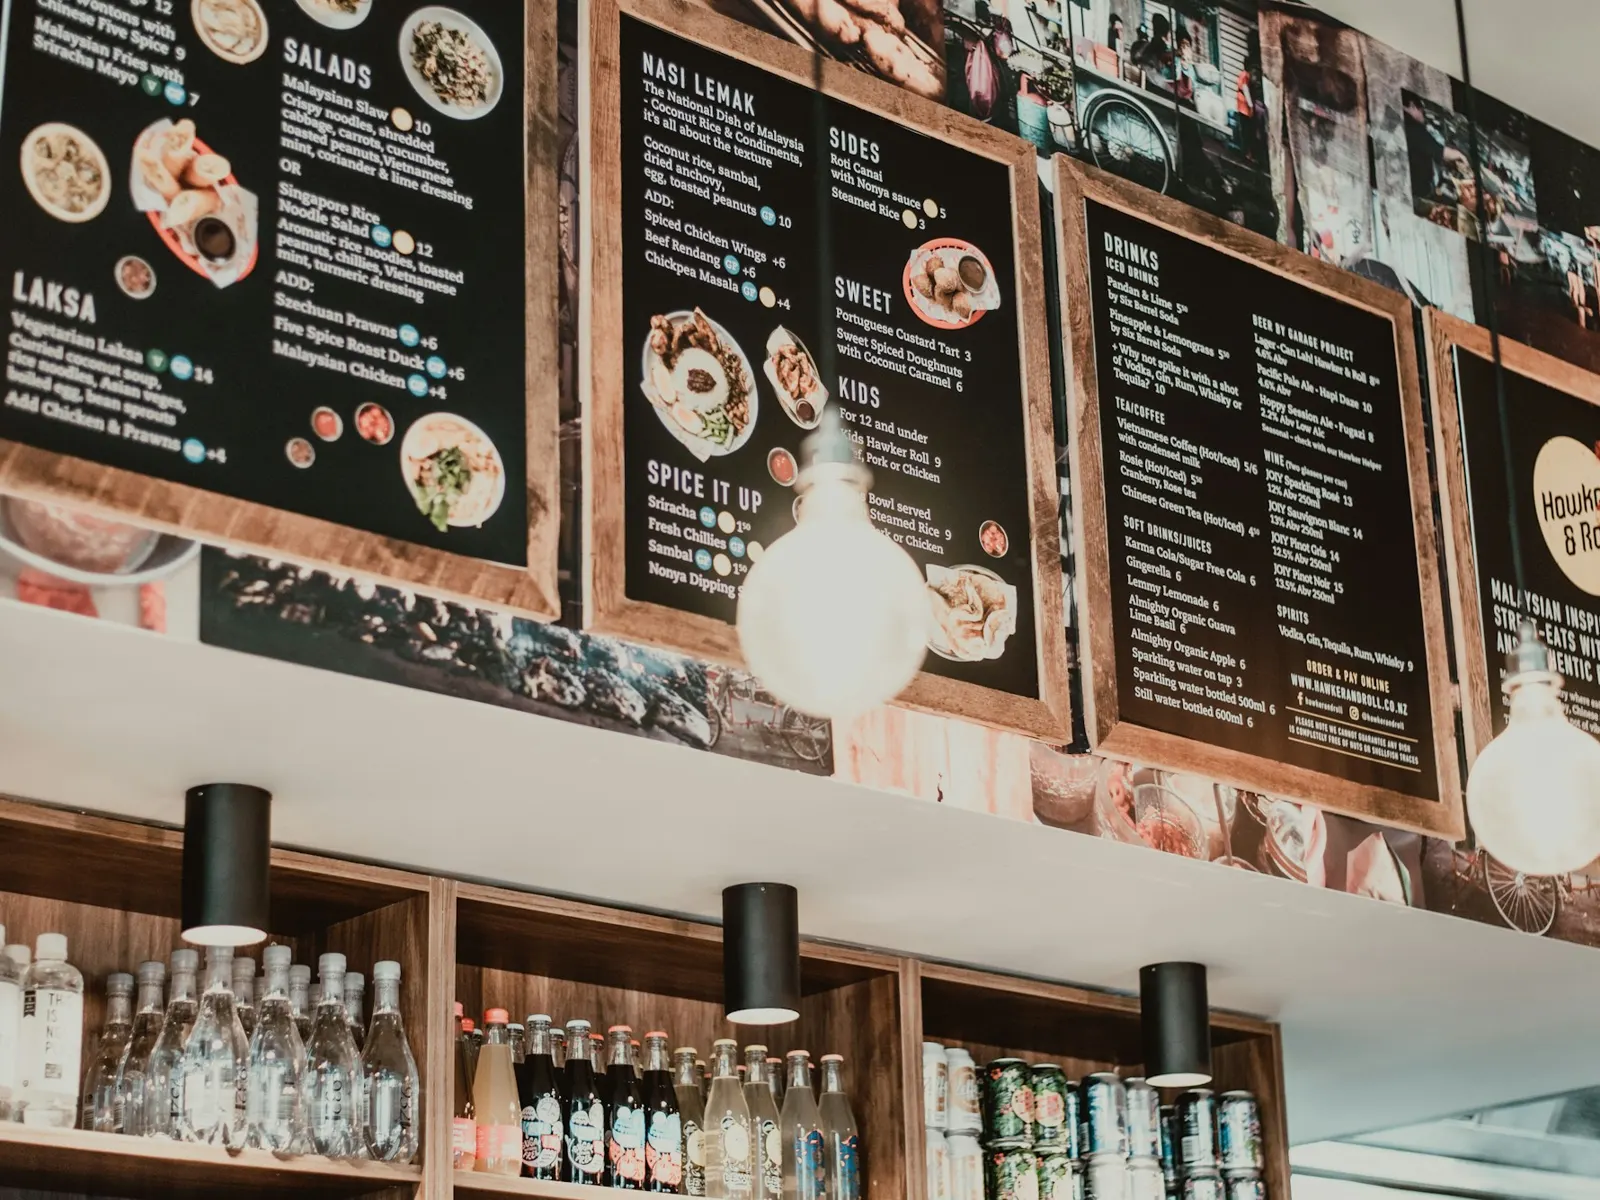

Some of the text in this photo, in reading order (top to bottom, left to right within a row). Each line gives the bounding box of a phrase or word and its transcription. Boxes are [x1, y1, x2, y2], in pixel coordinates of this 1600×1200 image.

[34, 16, 184, 85] Malaysian Fries with
[284, 38, 371, 90] SALADS
[283, 74, 431, 135] Malaysian Slaw 10
[642, 51, 755, 117] NASI LEMAK
[281, 92, 435, 153] Crispy noodles, shredded
[643, 79, 804, 152] The National Dish of Malaysia
[651, 99, 802, 167] Coconut Rice & Condiments,
[643, 109, 772, 168] it's all about the texture
[829, 126, 880, 164] SIDES
[280, 158, 302, 176] OR
[643, 135, 761, 191] Coconut rice, sambal,
[644, 151, 725, 192] dried anchovy,
[830, 153, 883, 182] Roti Canai
[279, 182, 380, 225] Singapore Rice
[644, 166, 792, 228] egg, toasted peanuts GF 10
[644, 189, 674, 209] ADD:
[831, 169, 946, 219] with Nonya sauce 5
[831, 186, 926, 230] Steamed Rice 3
[278, 198, 433, 258] Noodle Salad 12
[645, 209, 786, 269] Spiced Chicken Wings +6
[645, 229, 756, 278] Beef Rendang GF +6
[1104, 232, 1159, 271] DRINKS
[1106, 256, 1159, 288] ICED DRINKS
[13, 271, 96, 324] LAKSA
[276, 271, 314, 293] ADD:
[645, 250, 790, 310] Chickpea Masala GF +4
[835, 276, 891, 315] SWEET
[1107, 275, 1172, 310] Pandan & Lime
[274, 293, 438, 350] Szechuan Prawns +6
[1108, 289, 1179, 325] by Six Barrel Soda
[274, 316, 465, 381] Five Spice Roast Duck +6
[836, 307, 972, 362] Portuguese Custard Tart 3
[837, 328, 963, 378] Sweet Spiced Doughnuts
[1252, 314, 1353, 363] BEER BY GARAGE PROJECT
[273, 340, 447, 400] Malaysian Chicken +4
[837, 343, 963, 392] with Coconut Caramel 6
[838, 376, 880, 408] KIDS
[1115, 397, 1165, 425] TEA/COFFEE
[840, 407, 928, 444] For 12 and under
[1117, 417, 1258, 475] Vietnamese Coffee (Hot/Iced) 5/6
[867, 435, 907, 458] Hawker
[910, 449, 929, 465] Roll
[935, 457, 941, 467] 9
[1264, 449, 1284, 467] WINE
[648, 459, 762, 513] SPICE IT UP
[648, 495, 696, 520] Sriracha
[648, 517, 727, 549] Fresh Chillies
[648, 539, 693, 562] Sambal
[1123, 515, 1212, 554] SOFT DRINKS/JUICES
[649, 561, 687, 584] Nonya
[689, 572, 735, 598] Dipping
[1126, 556, 1182, 582] Gingerella 6
[1127, 574, 1219, 611] Lemmy Lemonade 6
[1277, 604, 1309, 625] SPIRITS
[1290, 673, 1408, 716] WWW.HAWKERANDROLL.CO.NZ
[1306, 660, 1390, 693] ORDER & PAY ONLINE
[1135, 686, 1253, 727] Still water bottled 600ml 6
